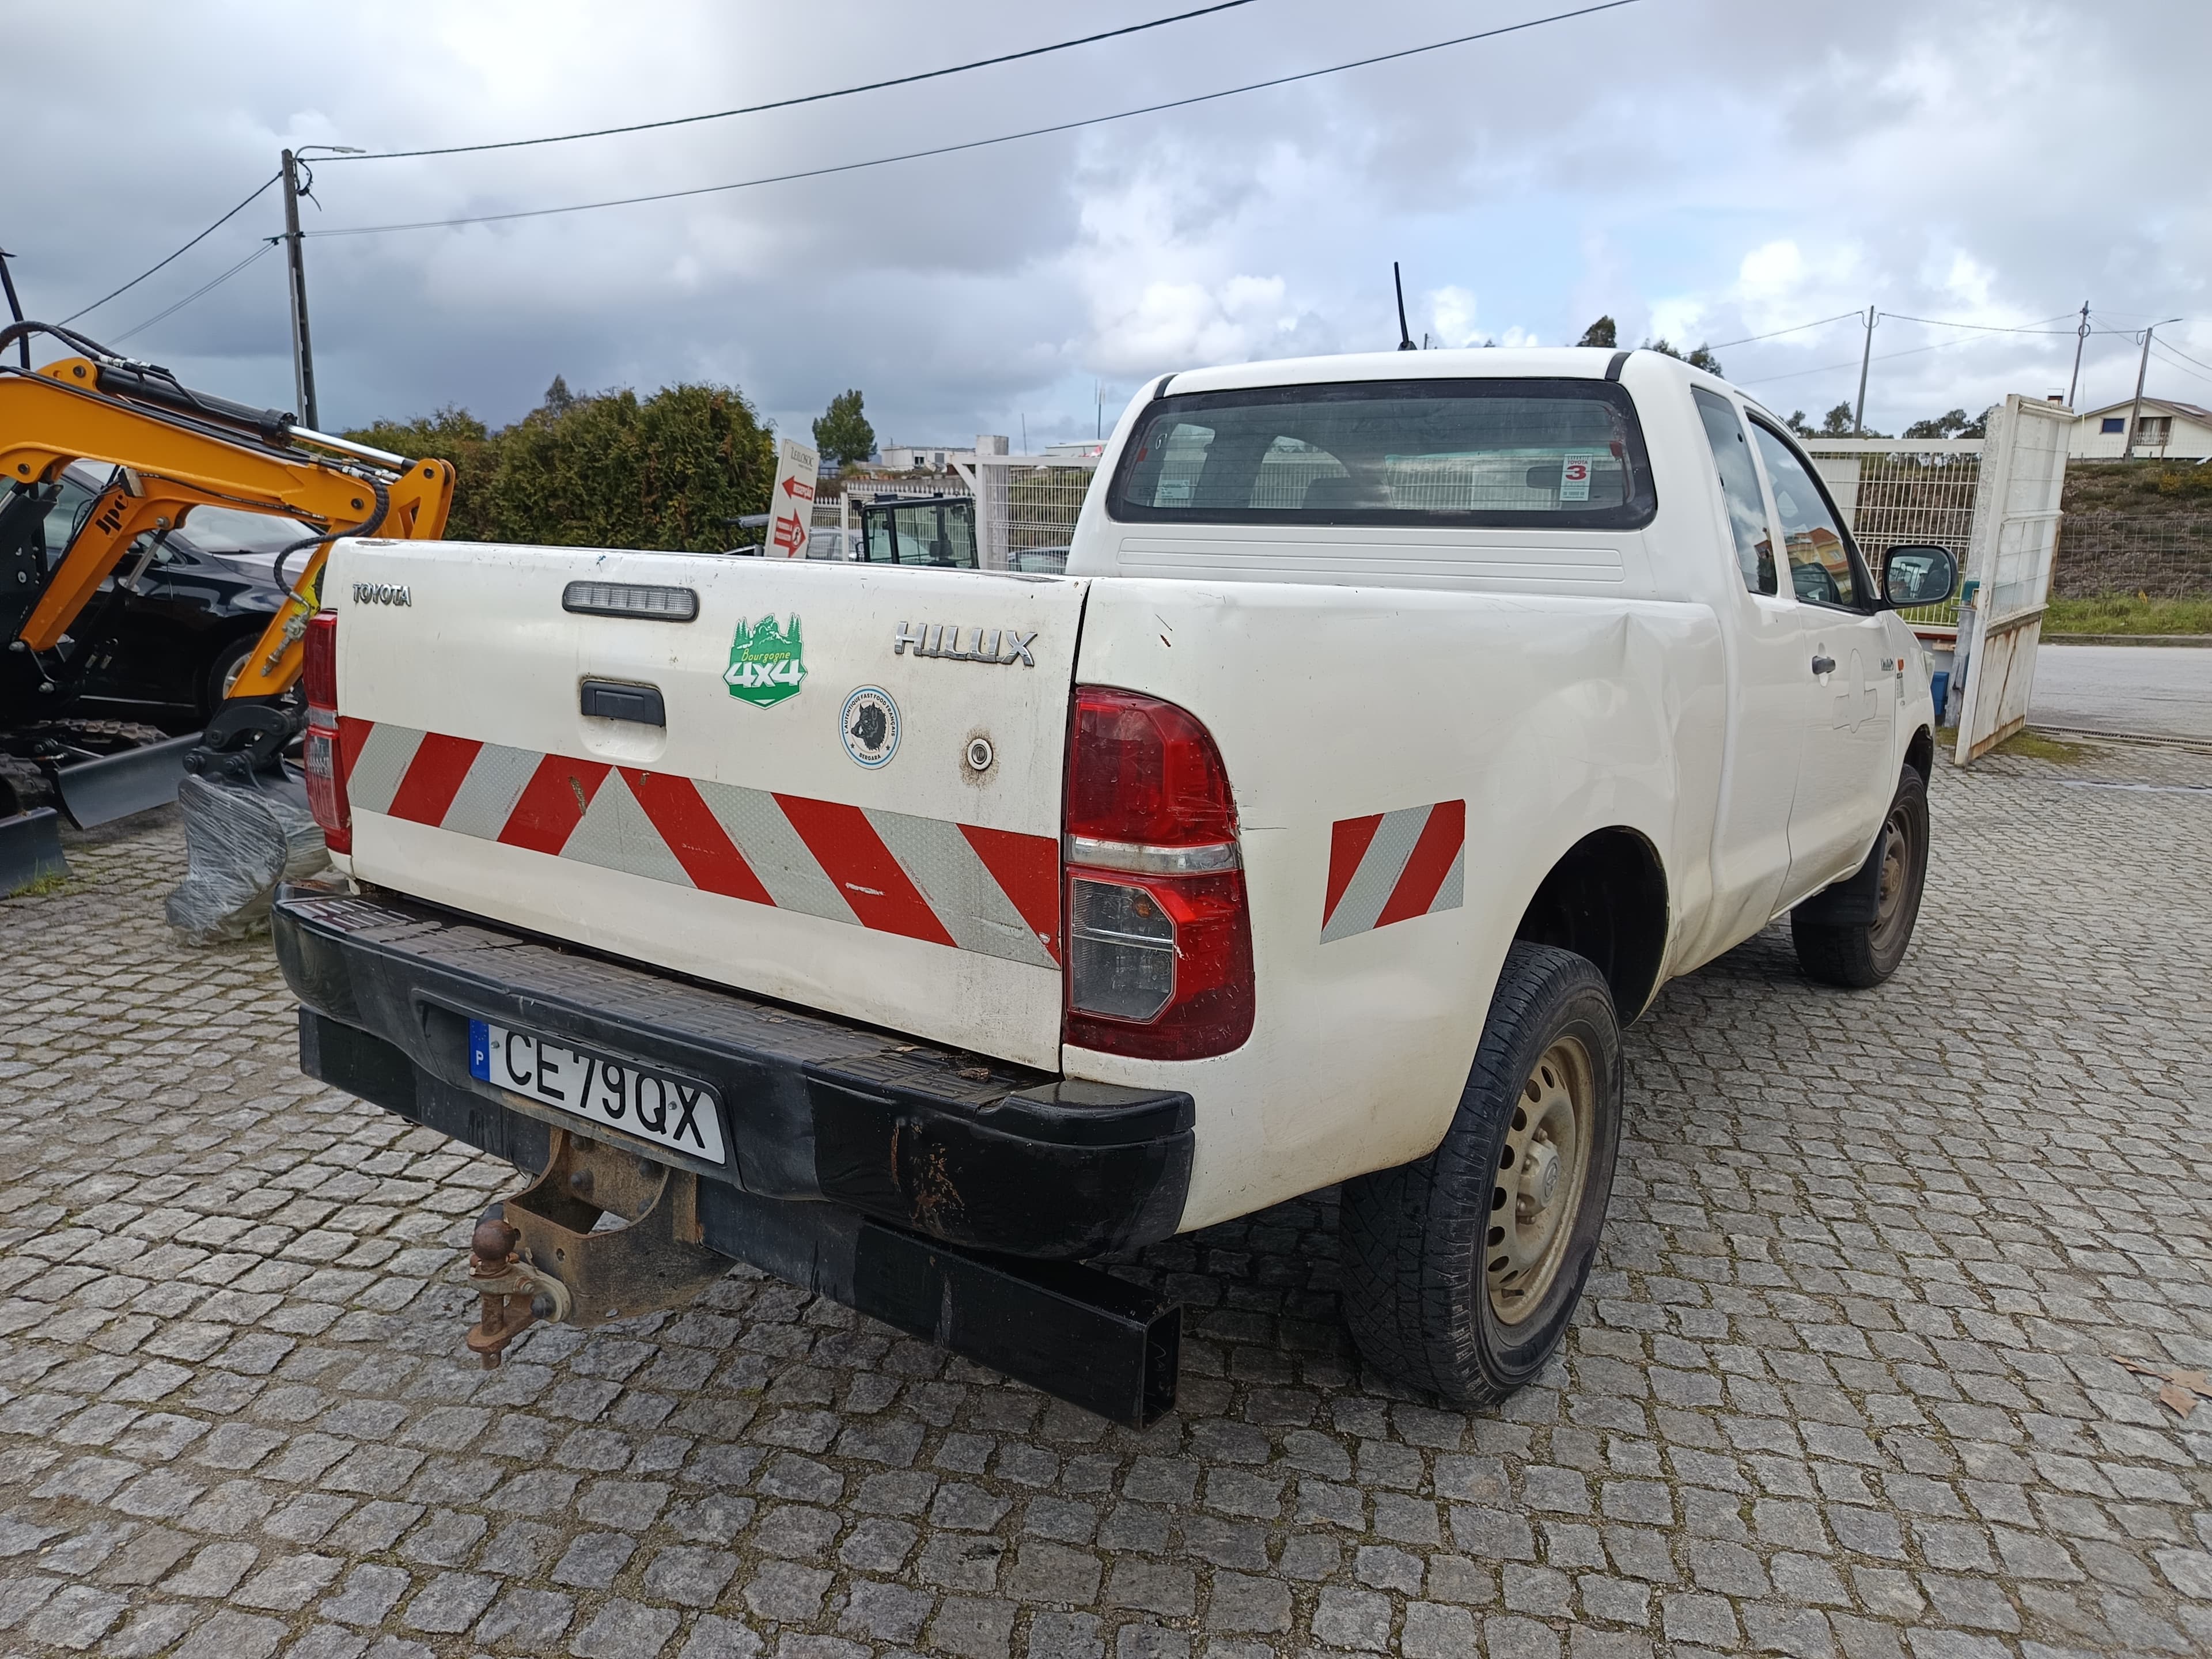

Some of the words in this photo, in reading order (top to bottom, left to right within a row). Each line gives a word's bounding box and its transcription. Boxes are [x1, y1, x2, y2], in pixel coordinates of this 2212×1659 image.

[1566, 465, 1587, 480] 3
[353, 582, 412, 607] TOYOTA
[895, 621, 1037, 666] HILUX
[741, 649, 791, 663] Bourgogne
[724, 659, 805, 688] 4x4
[873, 694, 887, 706] FOOD
[885, 704, 895, 736] FRANÇAIS
[859, 752, 881, 761] BERGARA
[475, 1050, 484, 1066] P
